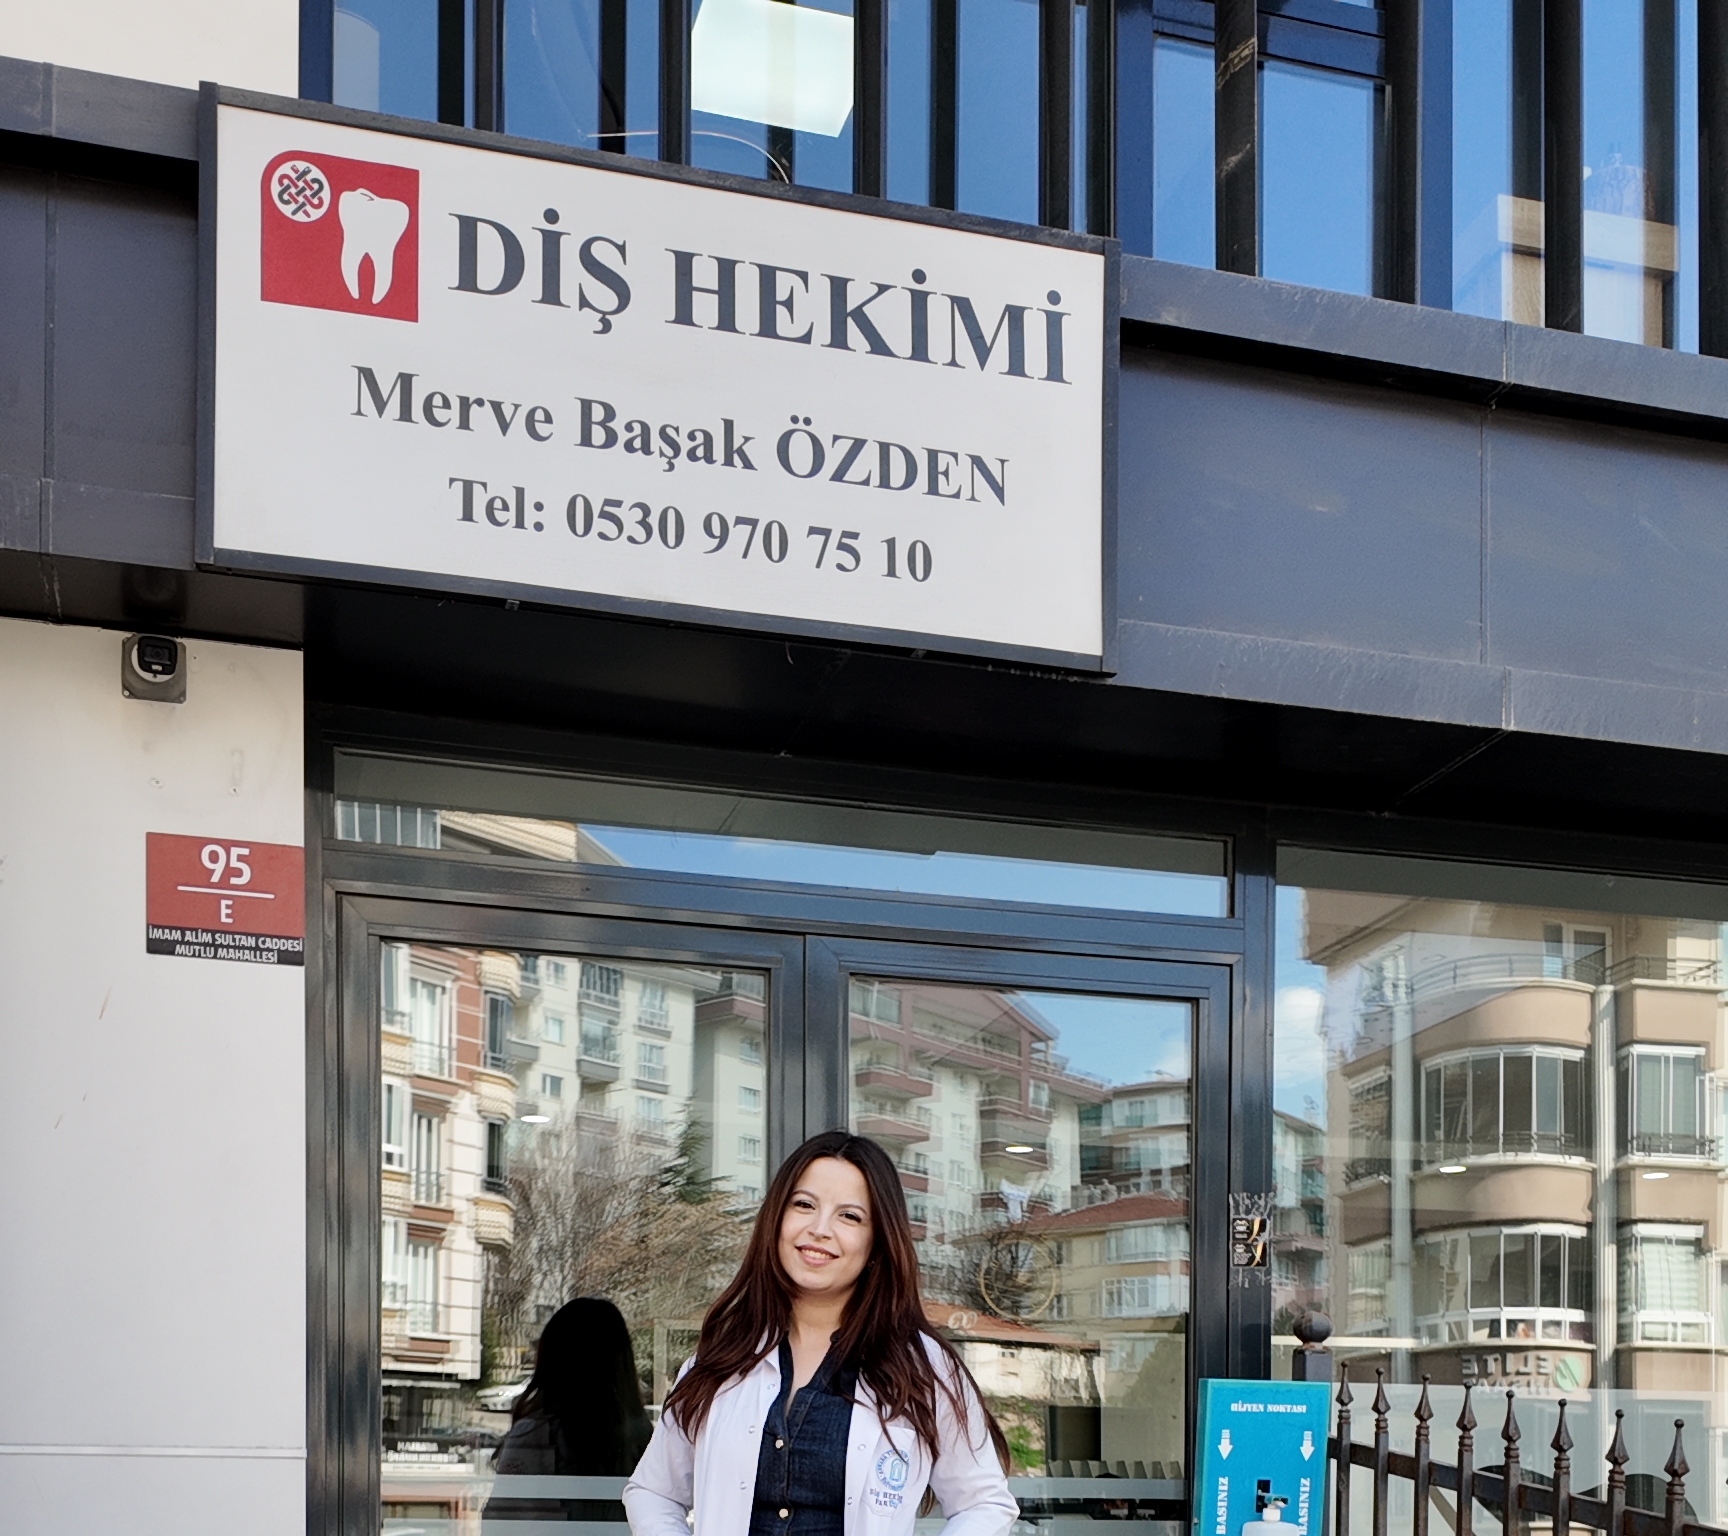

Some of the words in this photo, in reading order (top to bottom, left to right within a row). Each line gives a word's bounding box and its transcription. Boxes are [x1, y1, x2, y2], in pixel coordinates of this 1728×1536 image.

[448, 208, 631, 334] DİŞ
[665, 249, 1071, 384] HEKİMİ
[352, 366, 553, 441] Merve
[575, 398, 757, 472] Başak
[777, 415, 1009, 506] ÖZDEN
[449, 478, 544, 532] Tel:
[567, 494, 684, 549] 0530
[703, 512, 788, 563] 970
[807, 526, 860, 572] 75
[881, 537, 932, 582] 10
[200, 844, 252, 885] 95
[220, 899, 234, 923] E
[149, 925, 182, 941] İMAM
[185, 929, 213, 944] ALİM
[215, 933, 256, 948] SULTAN
[258, 938, 303, 952] CADDESİ
[175, 944, 214, 958] MUTLU
[217, 948, 278, 963] MAHALLESİ
[1216, 1476, 1229, 1535] BASINIZ
